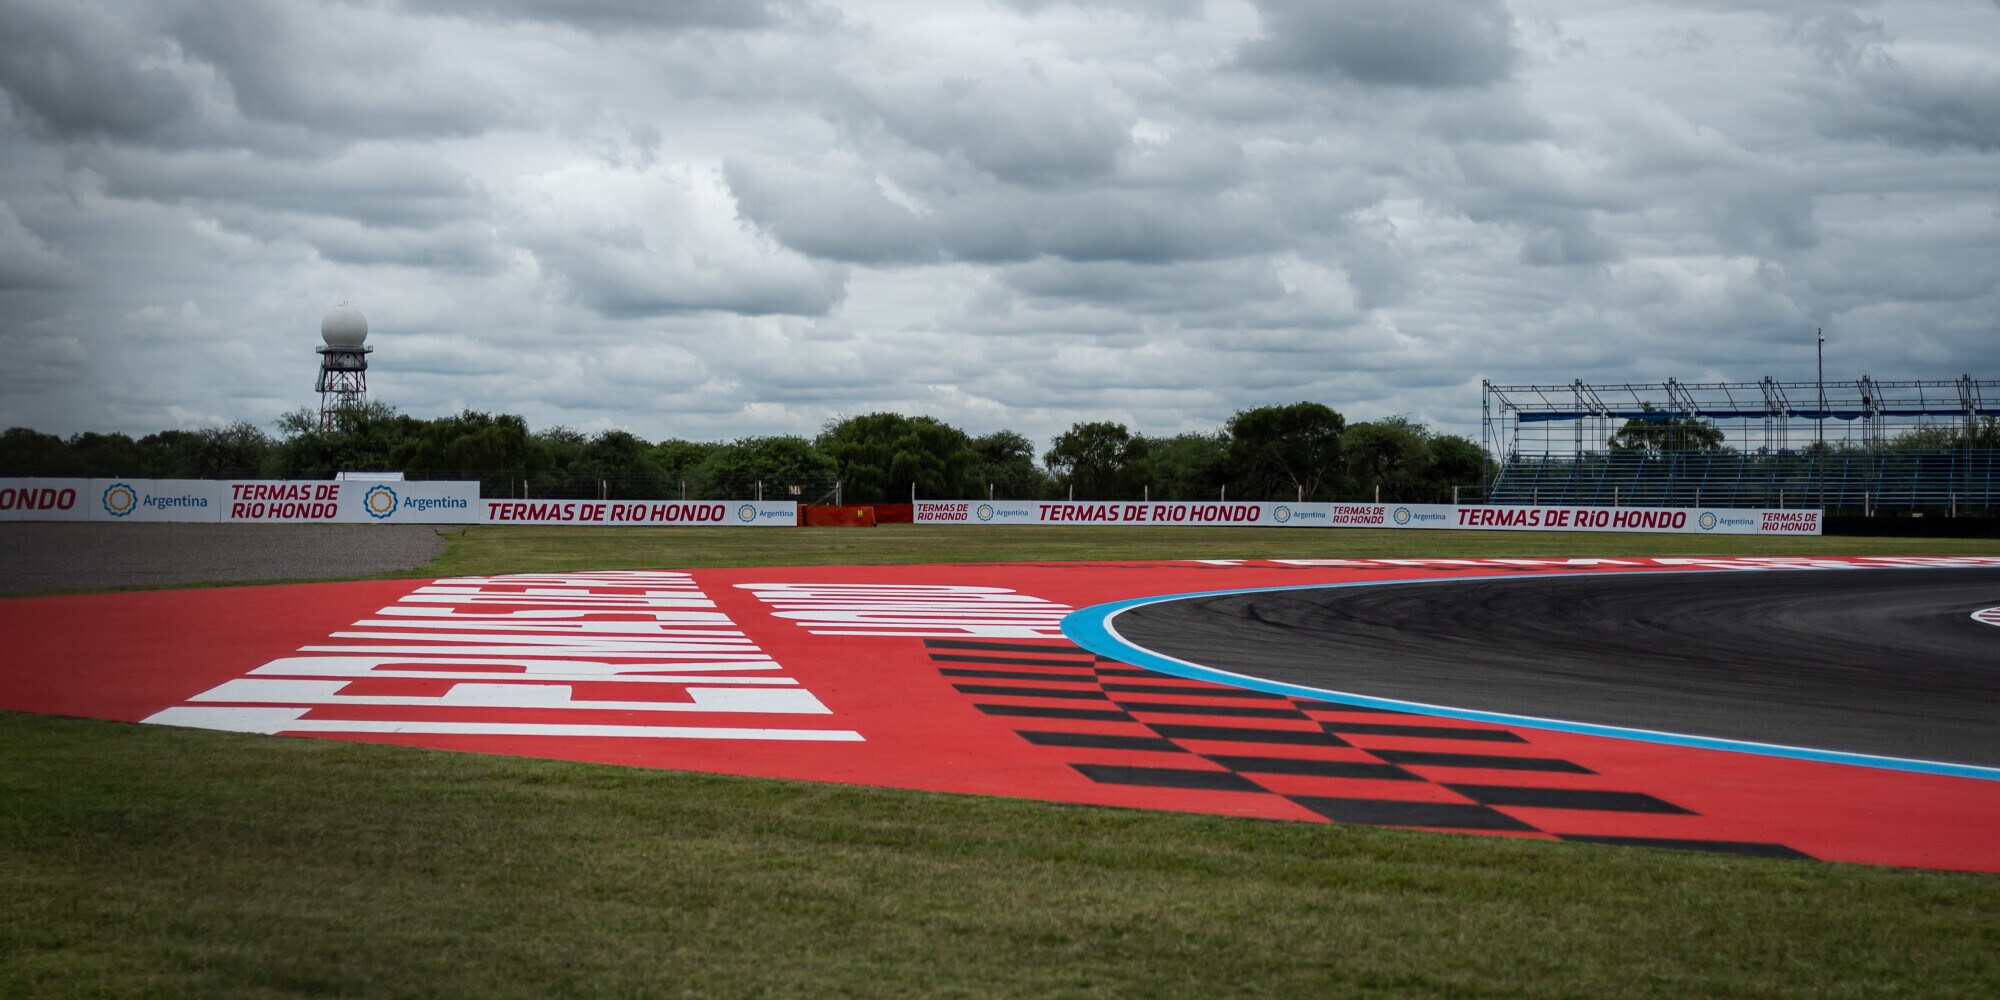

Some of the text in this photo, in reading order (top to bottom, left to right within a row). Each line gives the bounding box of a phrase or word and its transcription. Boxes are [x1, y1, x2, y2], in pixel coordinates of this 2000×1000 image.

[231, 484, 340, 501] TERMAS DE
[143, 494, 208, 510] Argentina
[403, 496, 468, 512] Argentina
[267, 502, 338, 519] HONDO
[487, 502, 576, 521] TERMAS
[579, 503, 607, 521] DE
[650, 504, 726, 522] HONDO
[917, 503, 969, 512] TERMAS DE
[1333, 506, 1386, 515] TERMAS DE
[759, 509, 794, 518] Argentina
[935, 512, 969, 521] HONDO
[996, 508, 1029, 518] Argentina
[1039, 504, 1120, 522] TERMAS
[1123, 505, 1149, 522] DE
[1189, 505, 1261, 522] HONDO
[1293, 510, 1326, 520] Argentina
[1413, 512, 1446, 522] Argentina
[1762, 512, 1818, 522] TERMAS DE
[1350, 515, 1385, 524] HONDO
[1457, 508, 1541, 527] TERMAS
[1544, 509, 1571, 527] DE
[1612, 510, 1687, 529] HONDO
[1719, 516, 1754, 527] Argentina
[1780, 522, 1817, 532] HONDO
[139, 606, 867, 742] TERMAS
